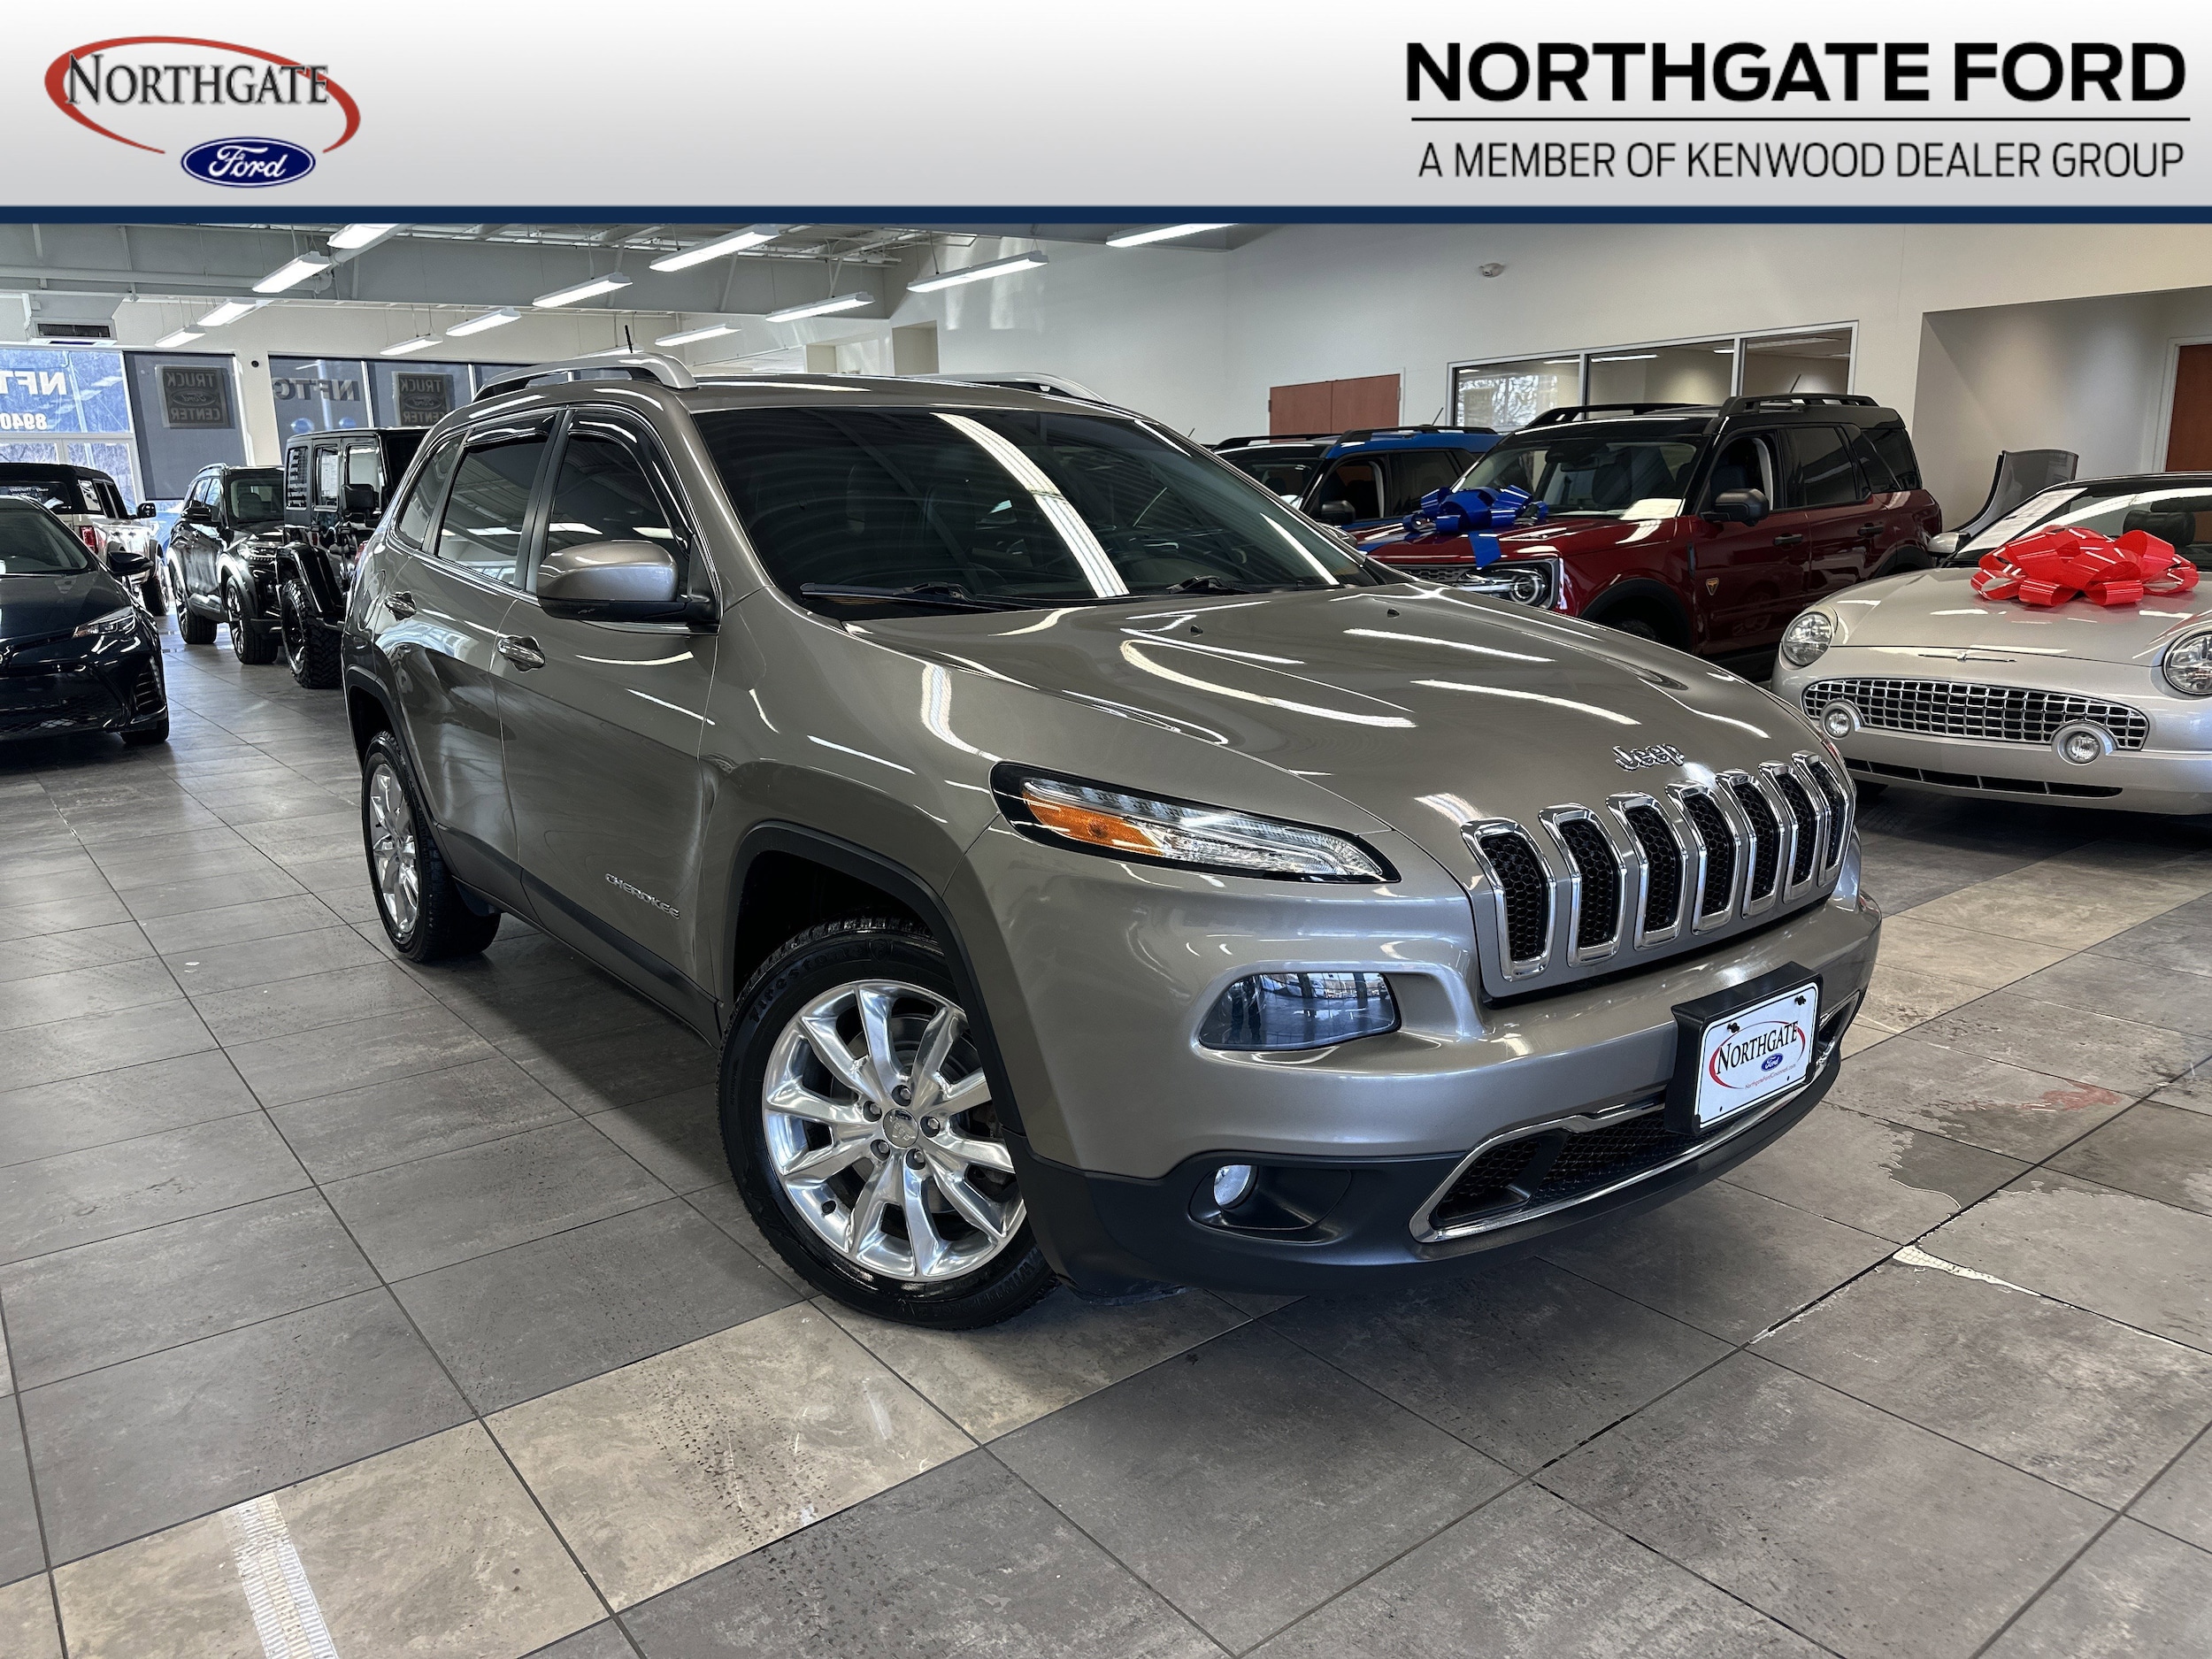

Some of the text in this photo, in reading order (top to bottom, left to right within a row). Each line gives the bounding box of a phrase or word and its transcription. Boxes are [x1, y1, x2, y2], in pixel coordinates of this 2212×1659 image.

[1611, 743, 1685, 772] Jeep
[604, 872, 680, 920] CHEROKEE
[1716, 1021, 1798, 1075] NORTHGATE
